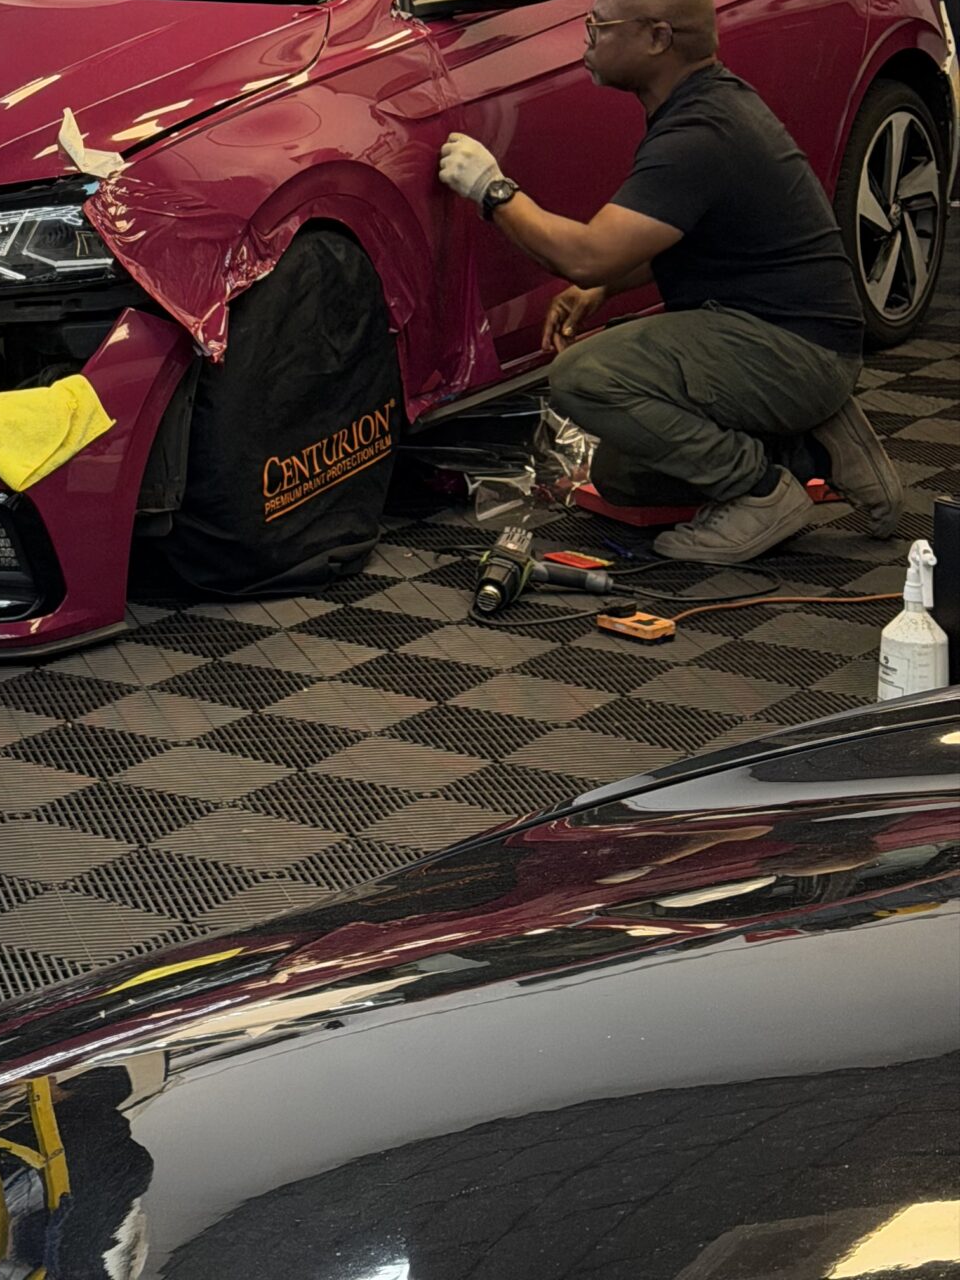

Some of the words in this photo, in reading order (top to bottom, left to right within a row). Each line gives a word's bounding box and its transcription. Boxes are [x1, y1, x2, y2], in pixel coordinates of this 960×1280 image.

[264, 485, 303, 515] PREMIUM
[303, 473, 326, 494] PAINT
[326, 447, 375, 481] PROTECTION
[374, 434, 392, 453] FILM
